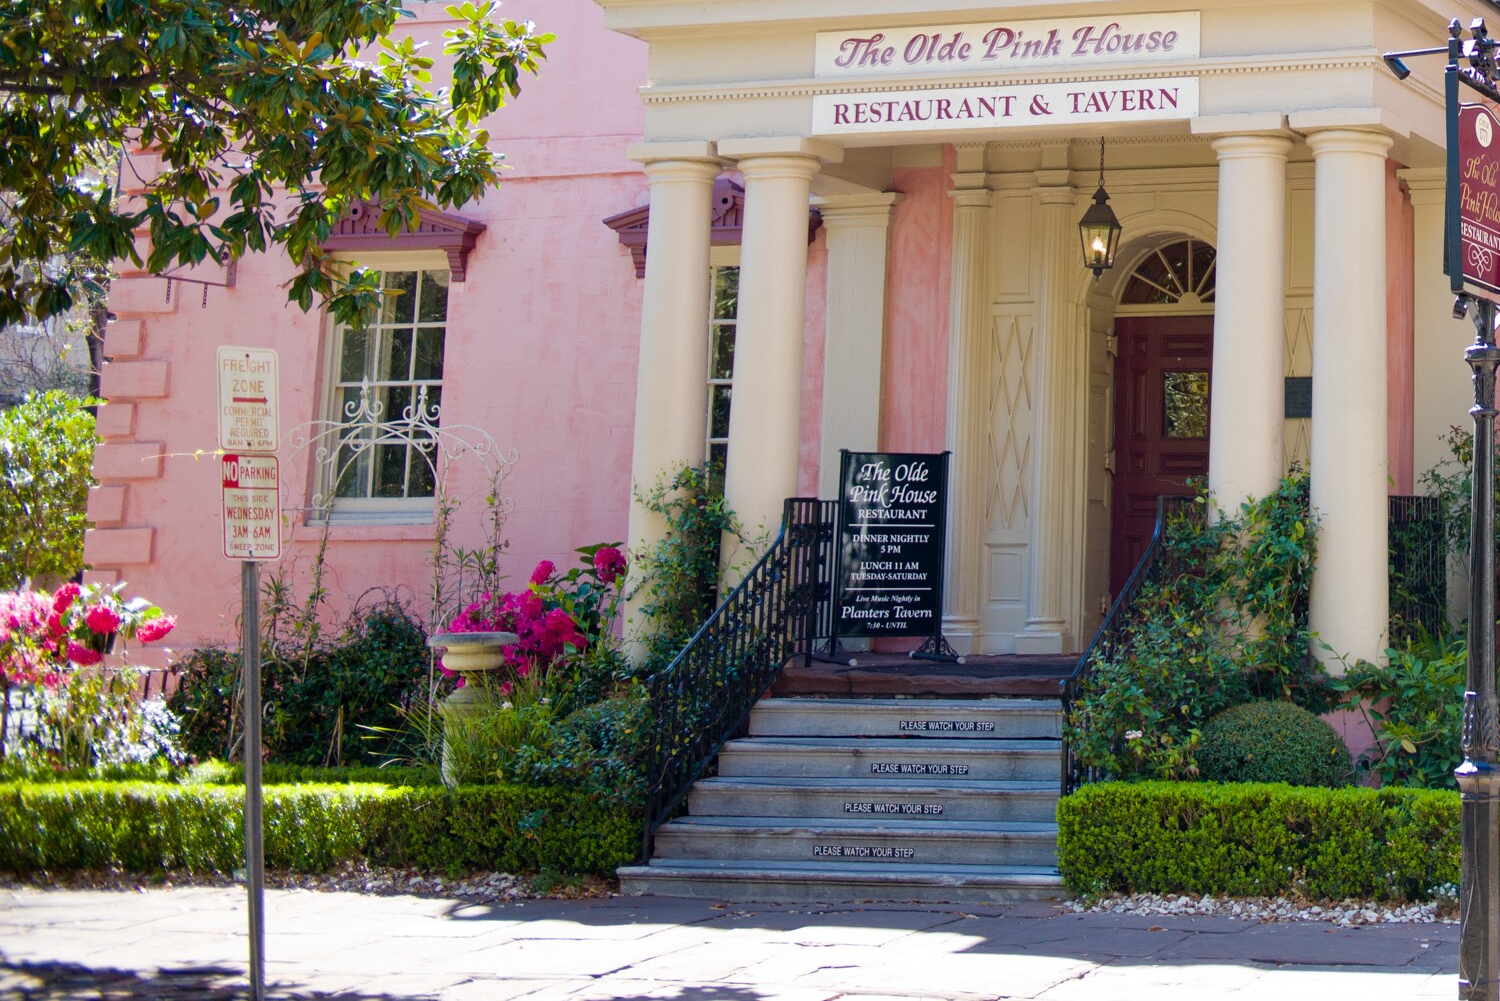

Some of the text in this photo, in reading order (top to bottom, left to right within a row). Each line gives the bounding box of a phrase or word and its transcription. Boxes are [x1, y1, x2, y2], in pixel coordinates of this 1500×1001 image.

[834, 22, 1178, 68] The Olde Pink House
[833, 88, 1179, 124] RESTAURANT & TAVERN
[1464, 154, 1499, 187] The Olde
[1460, 182, 1480, 214] Pink
[223, 359, 272, 374] FREIGHT
[232, 379, 264, 393] ZONE
[235, 417, 264, 427] PERMIT
[230, 427, 269, 438] REQUIRED
[223, 461, 276, 482] NO PARKING
[861, 461, 929, 482] The Olde
[252, 495, 269, 503] SIDE
[849, 482, 937, 508] Pink House
[226, 506, 275, 520] WEDNESDAY
[858, 509, 927, 519] RESTAURANT
[232, 525, 271, 538] 3AM-6AM
[852, 534, 930, 543] DINNER NIGHTLY
[229, 543, 275, 551] SWEEP ZONE
[880, 545, 901, 553] 5 PM
[861, 562, 919, 570] LUNCH 11 AM
[891, 595, 913, 603] Nightly
[841, 606, 933, 618] Planters Tavern
[900, 721, 995, 731] PLEASE WATCH YOUR STEP
[872, 763, 968, 774] PLEASE WATCH YOUR STEP
[845, 803, 943, 814] PLEASE WATCH YOUR STEP
[814, 846, 914, 857] PLEASE WATCH YOUR STEP
